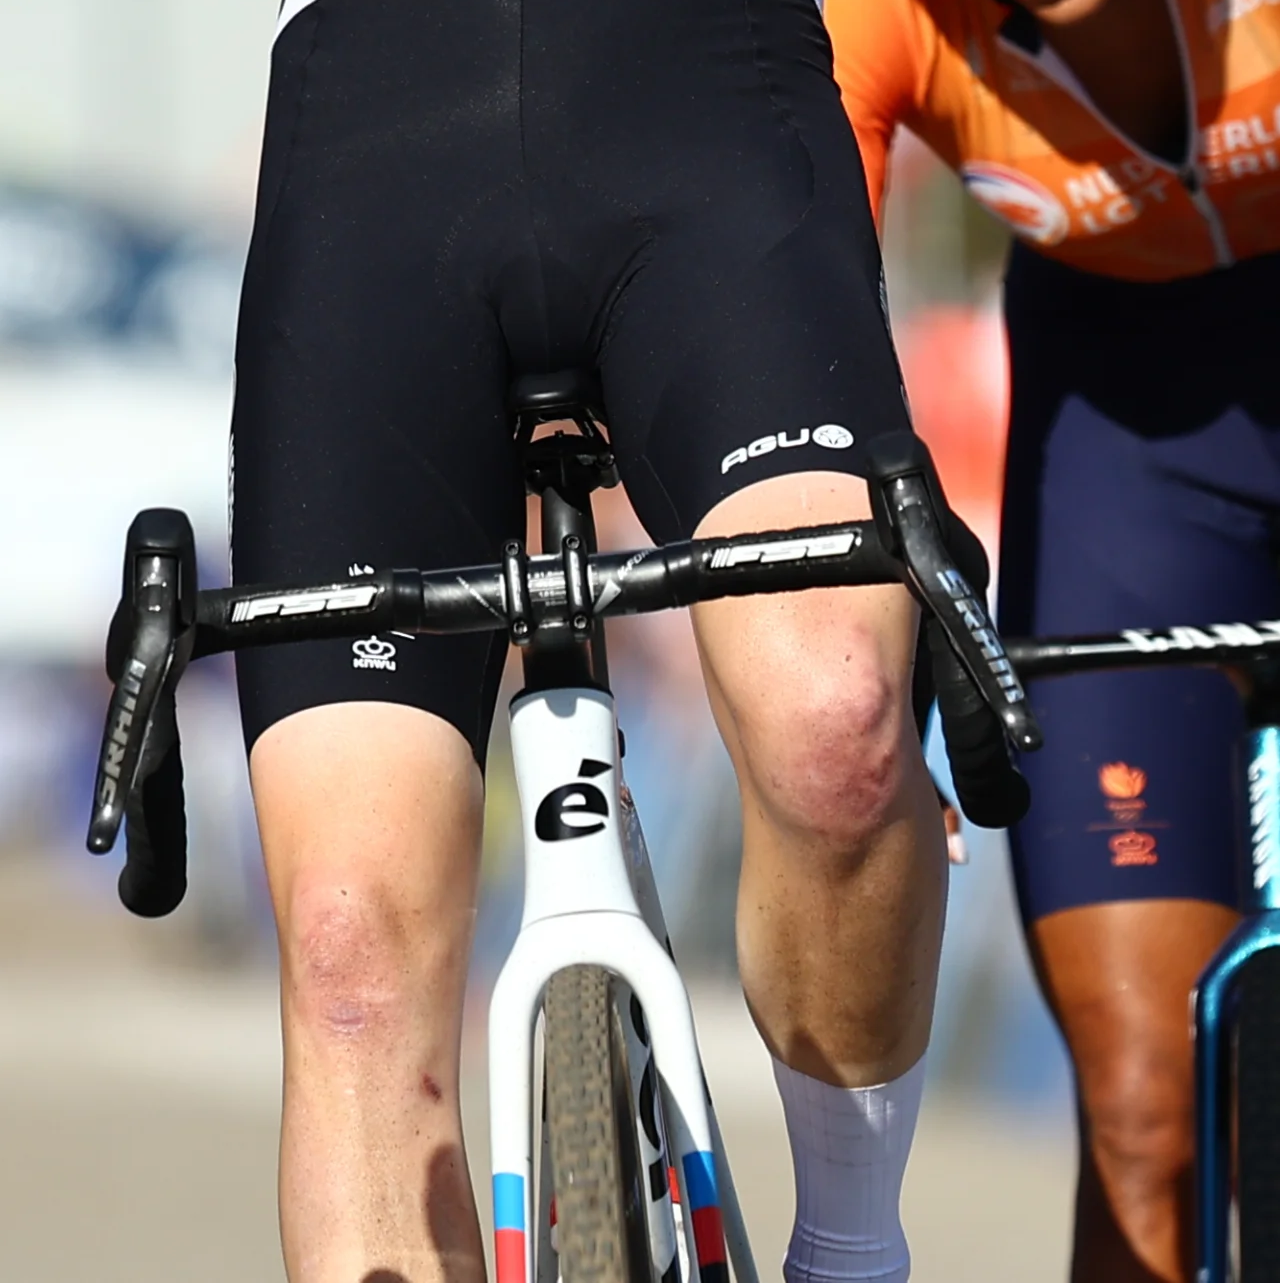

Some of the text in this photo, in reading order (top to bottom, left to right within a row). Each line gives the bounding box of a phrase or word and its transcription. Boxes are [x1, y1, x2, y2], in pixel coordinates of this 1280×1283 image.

[721, 428, 811, 475] AGU
[936, 570, 1025, 704] SRAM
[100, 658, 146, 808] SRAM
